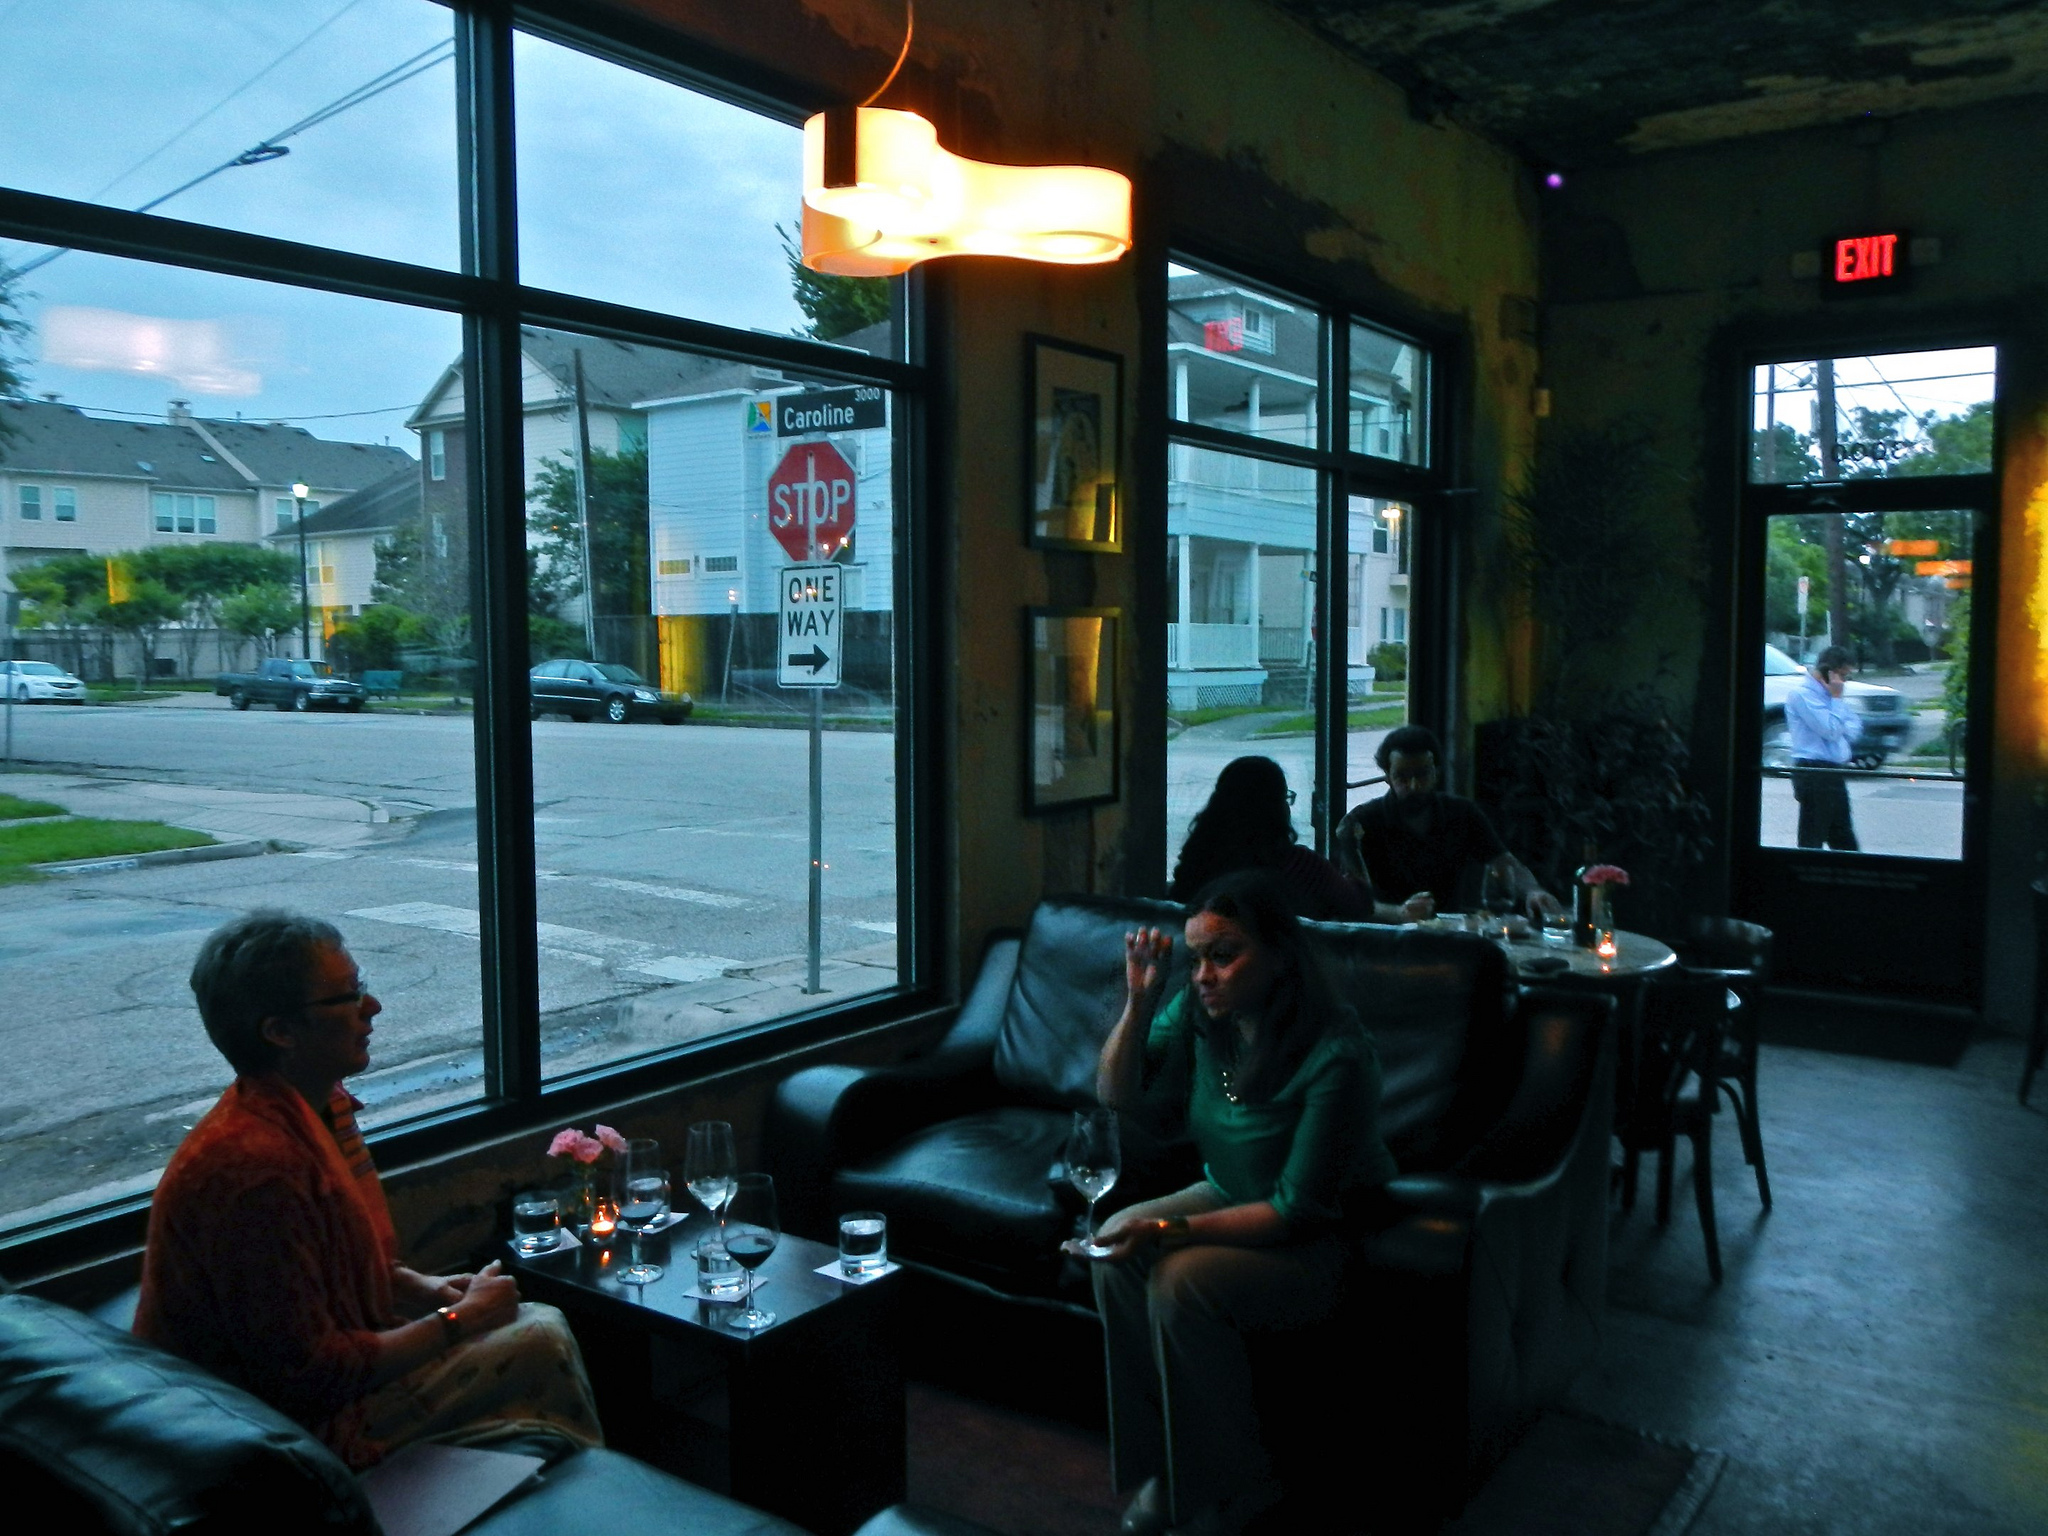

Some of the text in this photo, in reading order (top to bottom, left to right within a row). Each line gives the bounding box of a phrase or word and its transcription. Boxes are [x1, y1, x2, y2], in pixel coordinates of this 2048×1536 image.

[1835, 234, 1898, 282] EXIT
[854, 387, 880, 401] 3000
[784, 403, 855, 430] Caroline
[773, 479, 851, 527] STOP
[789, 576, 834, 603] ONE
[787, 610, 835, 636] WAY
